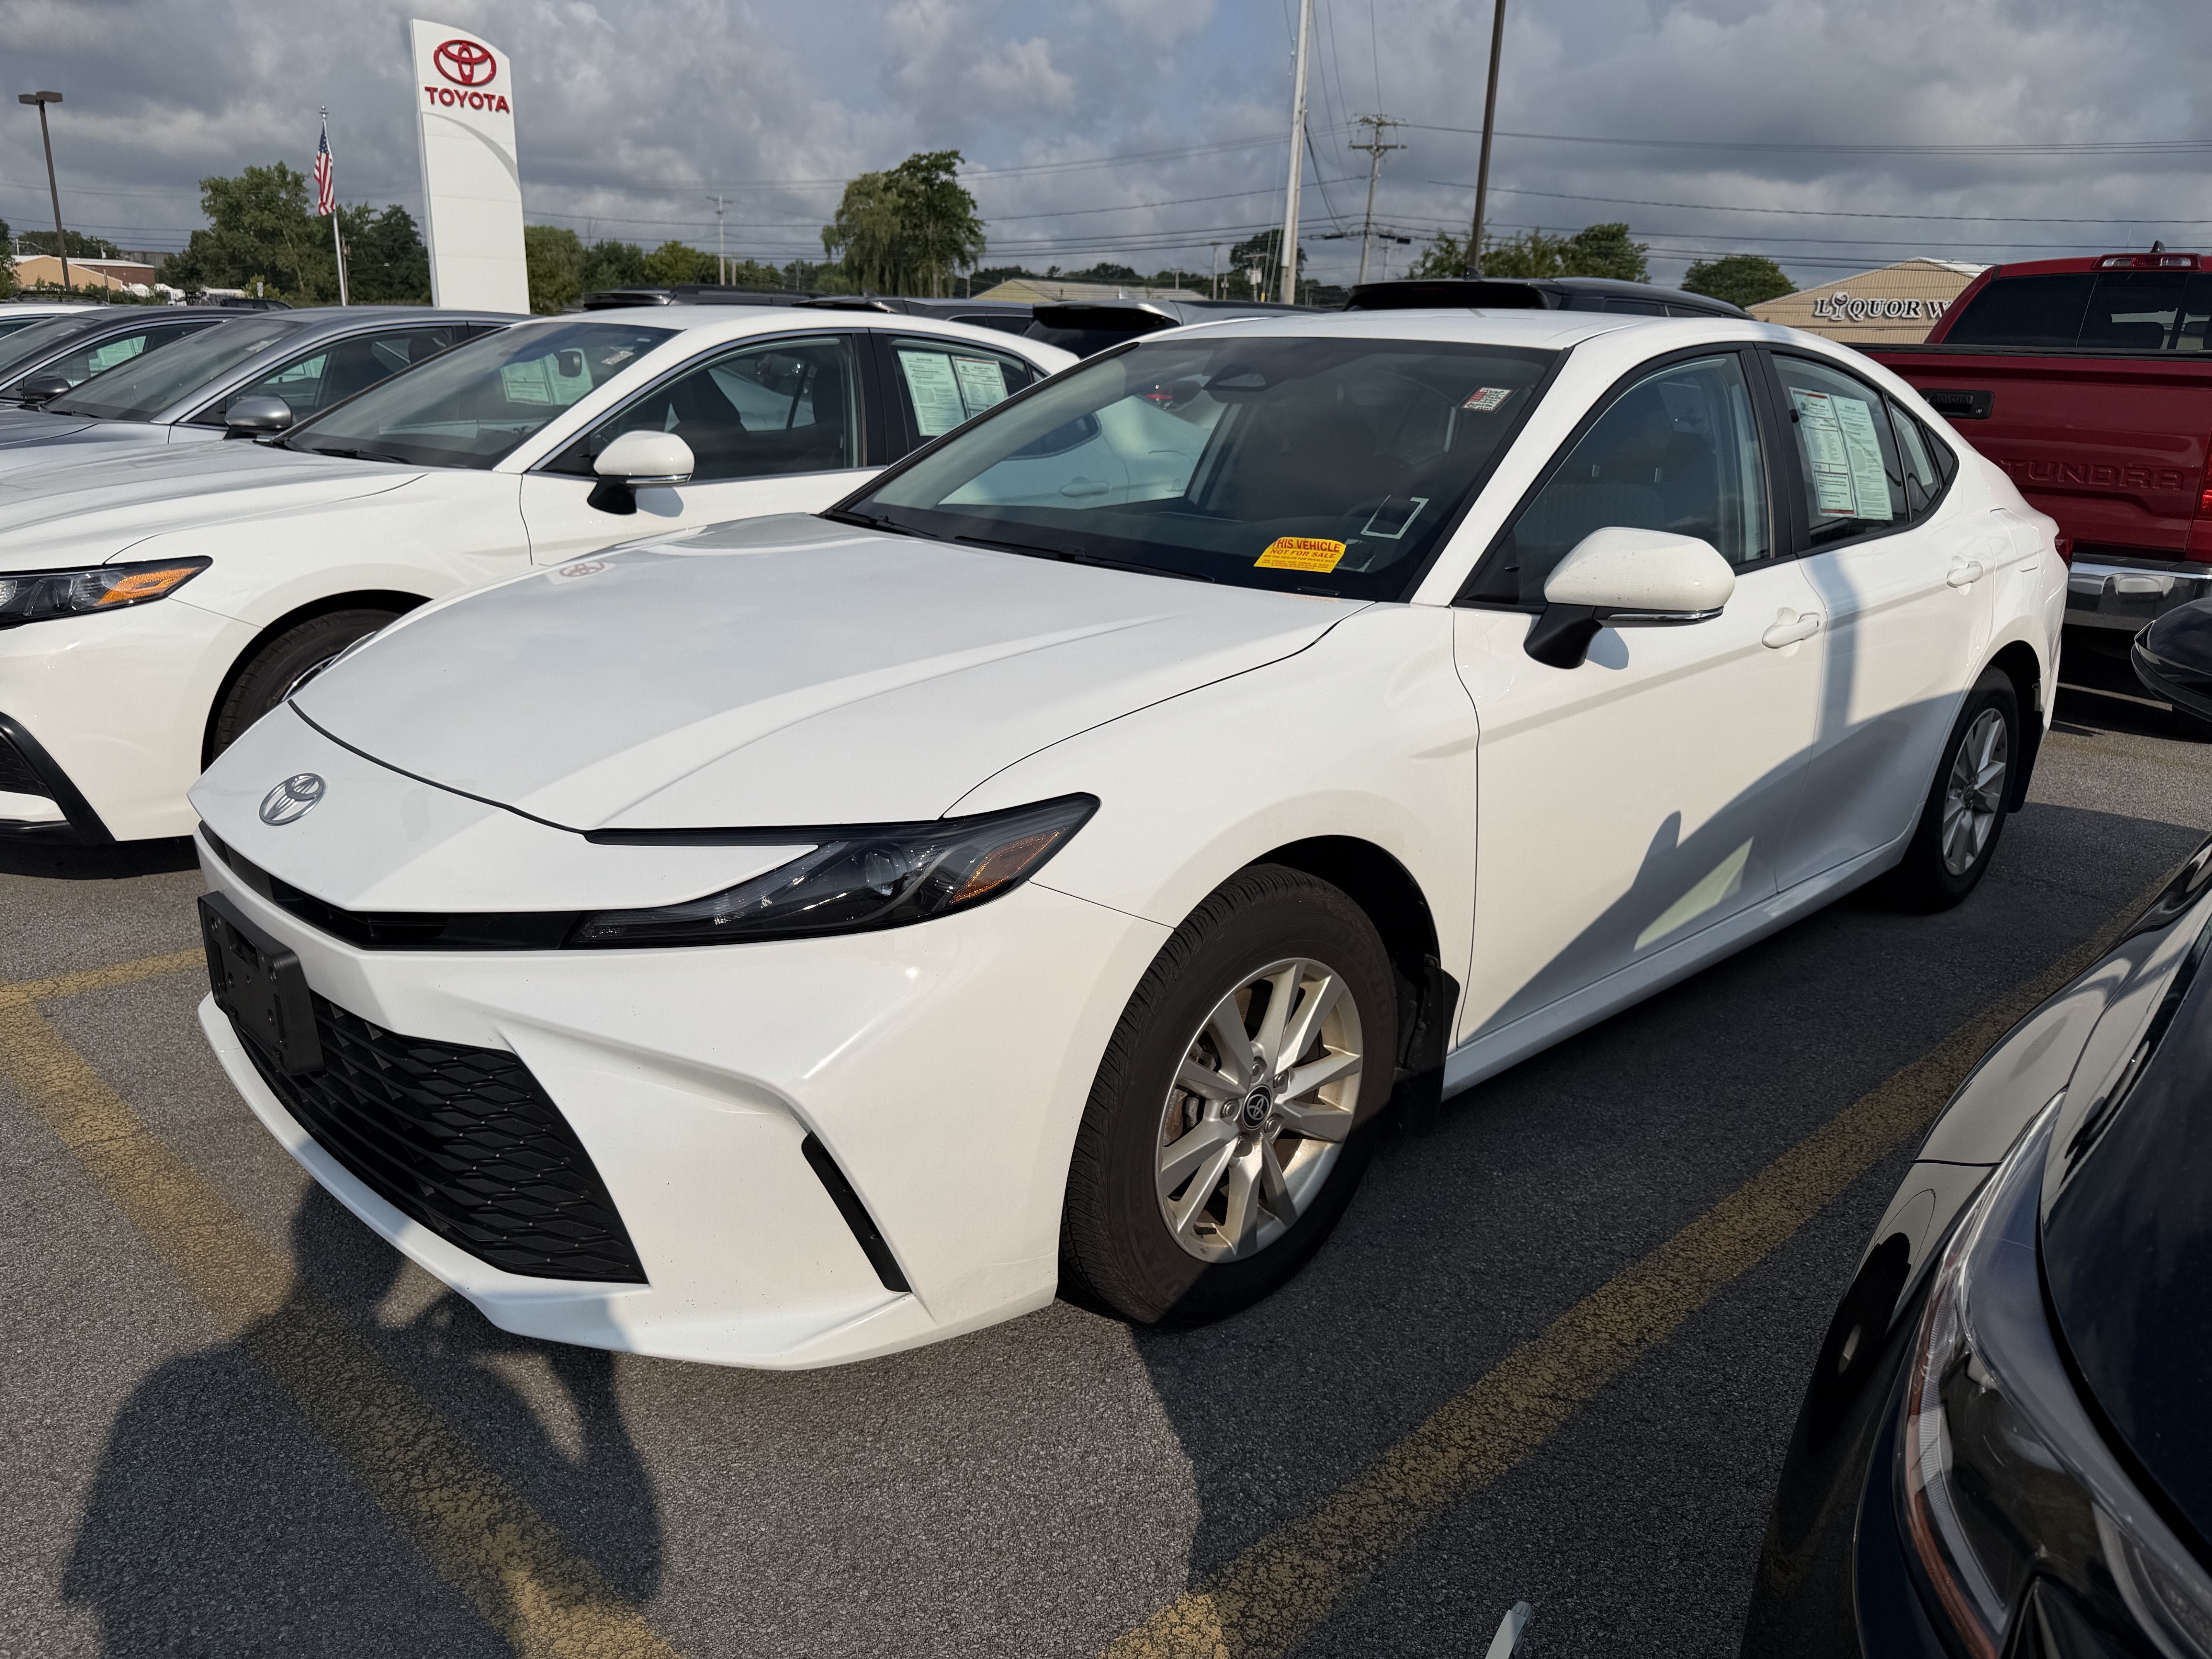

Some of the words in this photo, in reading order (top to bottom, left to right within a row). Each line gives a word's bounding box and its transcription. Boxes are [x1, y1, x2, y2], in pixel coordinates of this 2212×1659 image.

[424, 86, 510, 113] TOYOTA
[1814, 291, 1923, 321] LIQUOR
[1999, 459, 2185, 491] TUNDRA
[1297, 539, 1341, 552] VEHICLE
